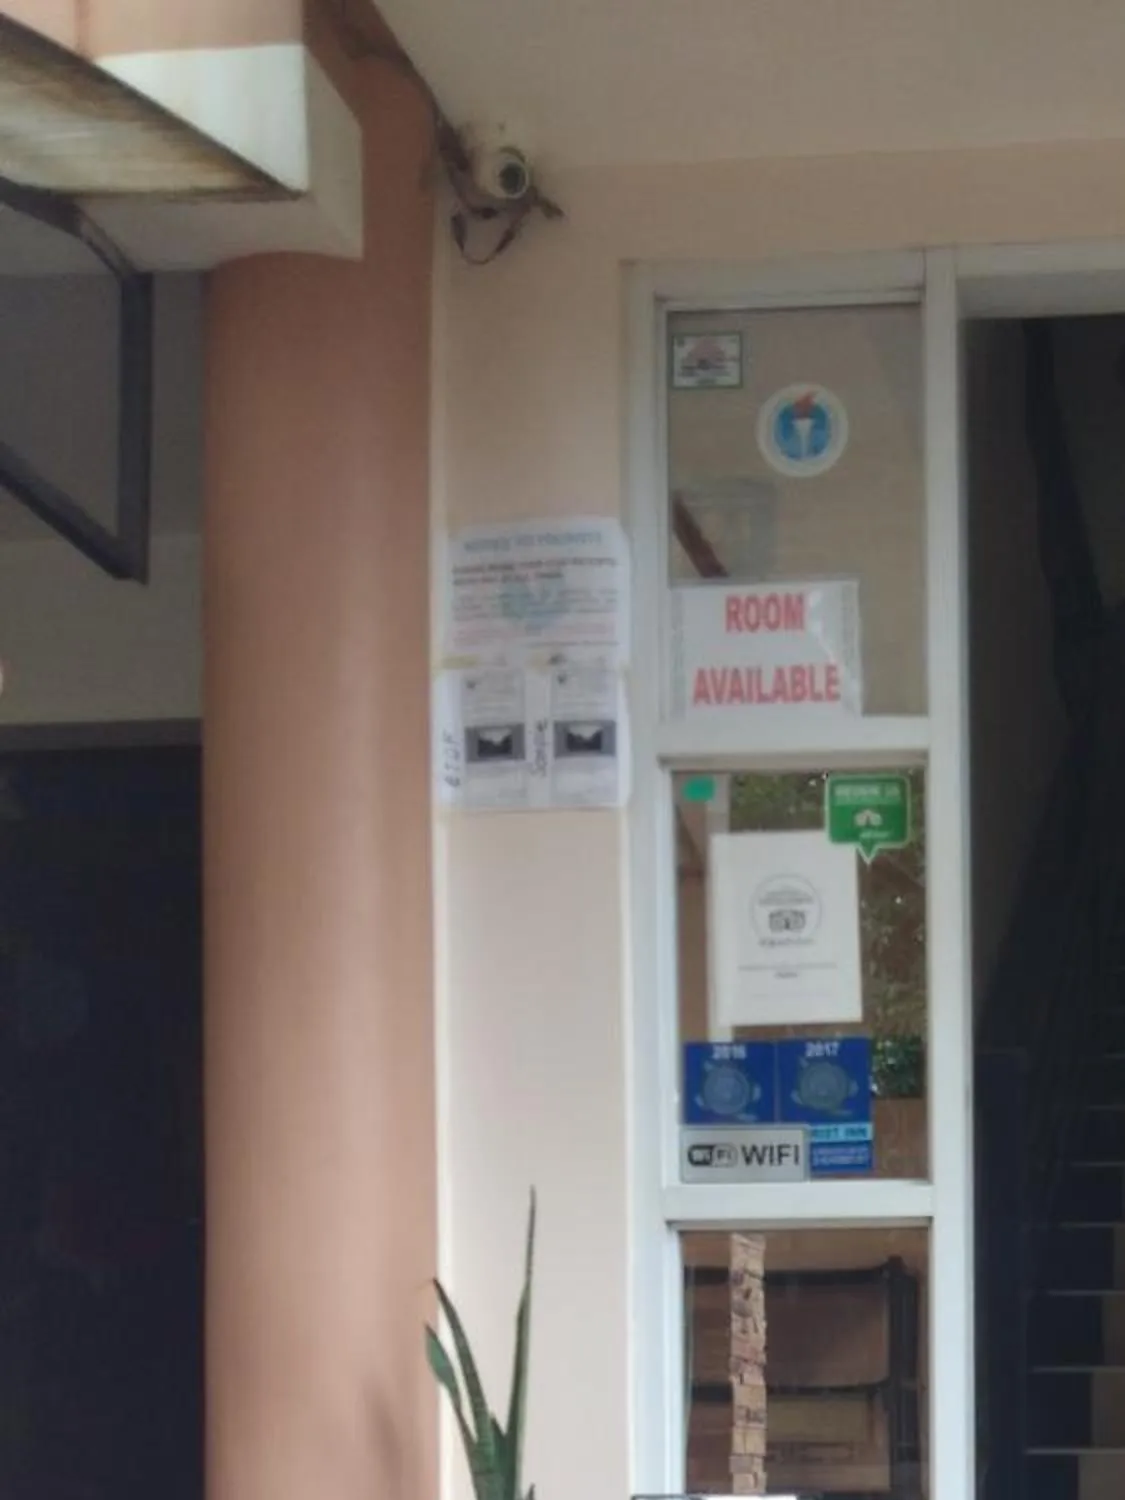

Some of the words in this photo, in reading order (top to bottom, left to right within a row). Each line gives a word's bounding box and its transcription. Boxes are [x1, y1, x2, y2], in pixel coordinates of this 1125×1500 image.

[726, 592, 804, 633] ROOM
[692, 663, 841, 705] AVAILABLE
[805, 1041, 839, 1057] 2017
[741, 1143, 800, 1166] WIFI
